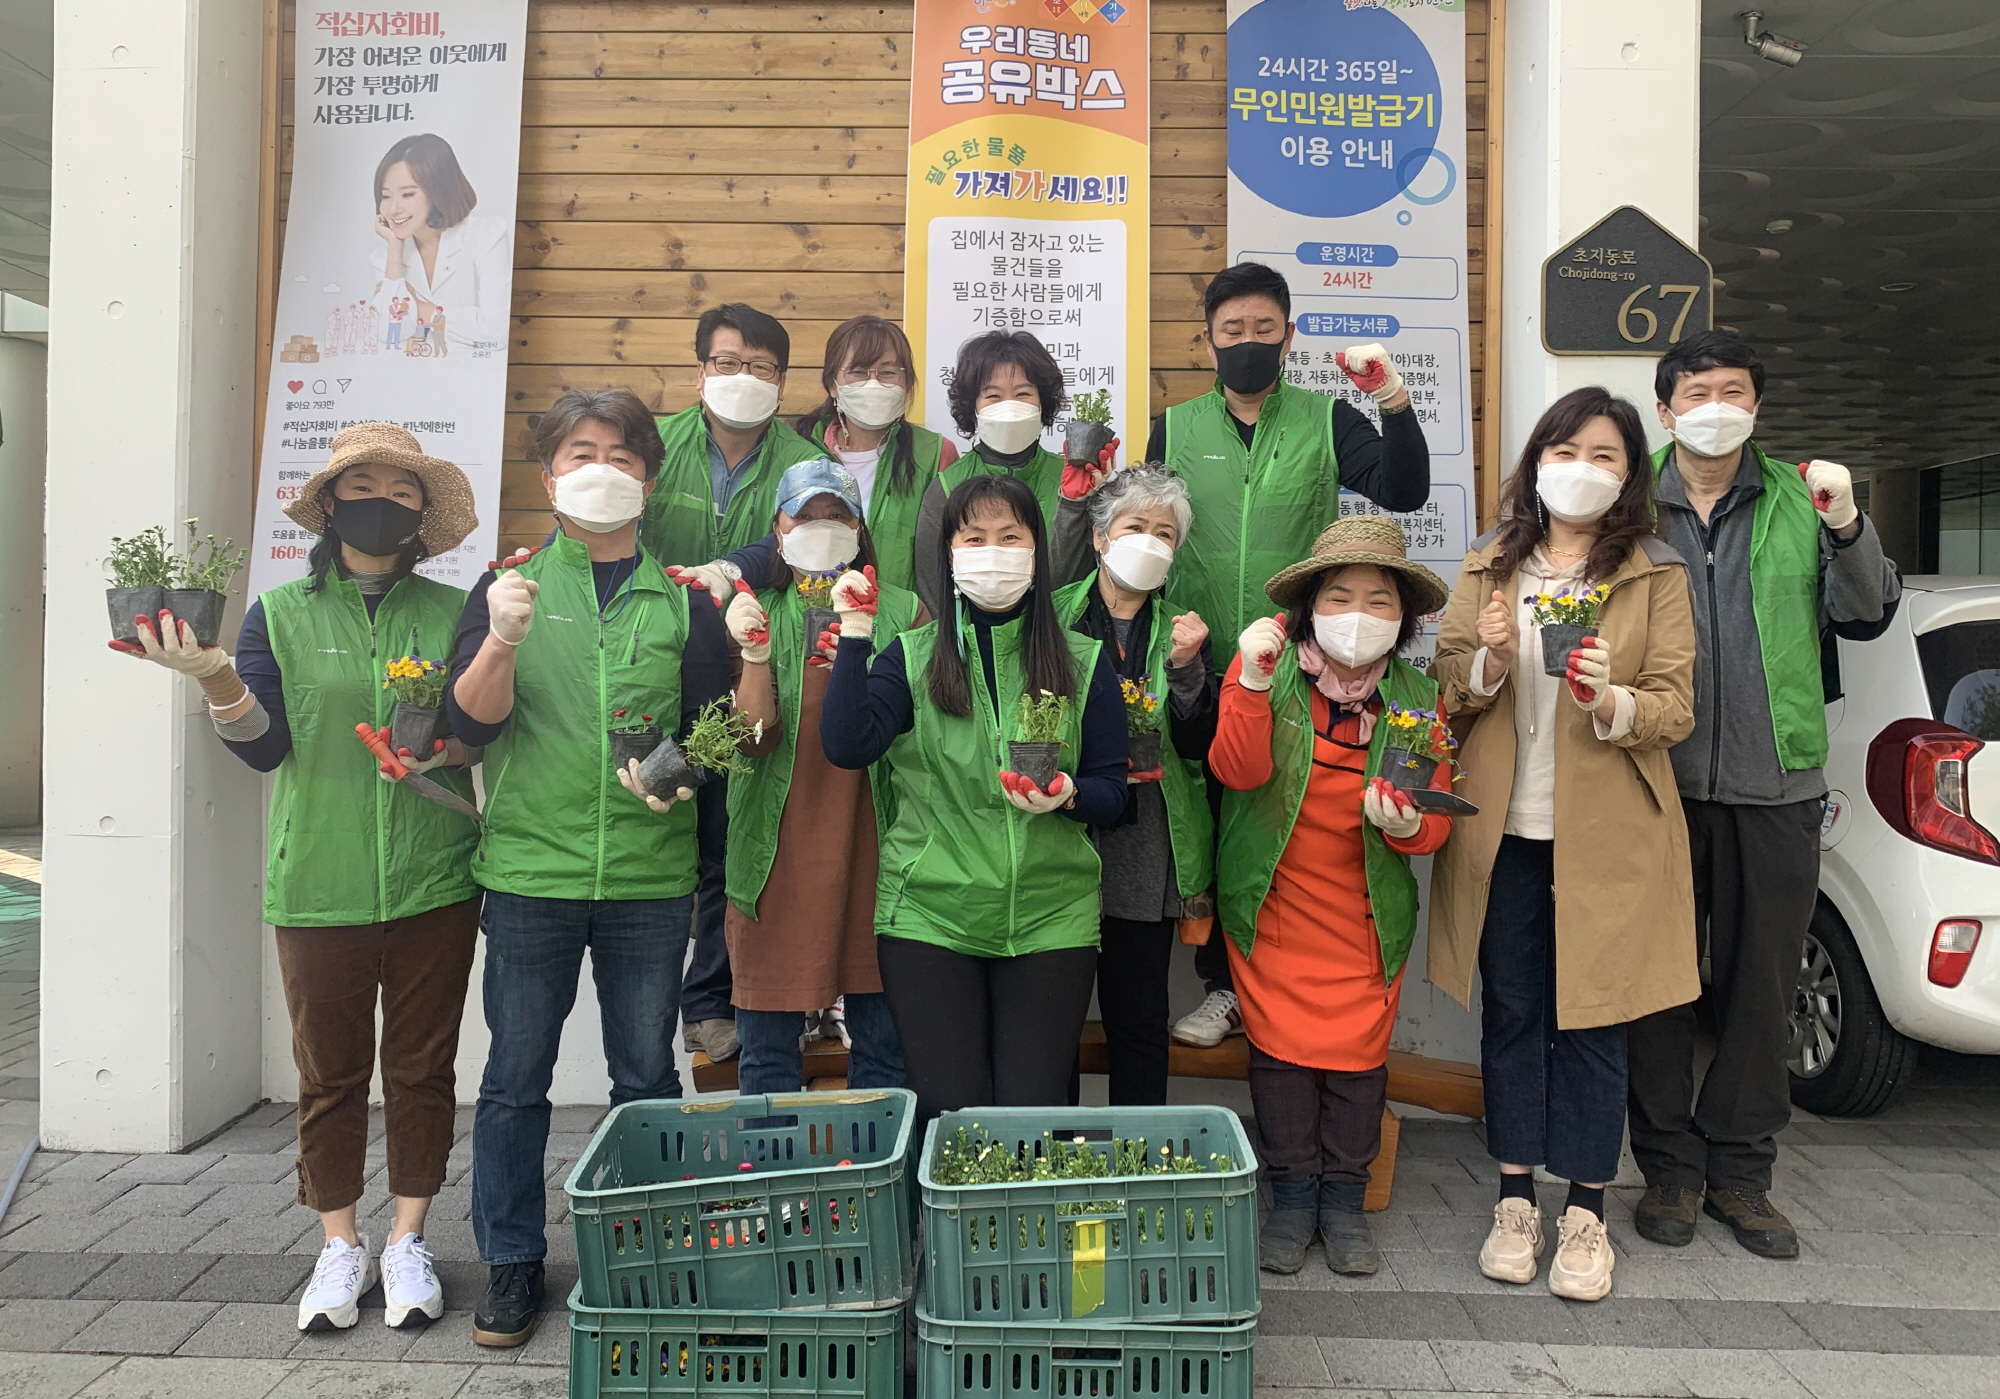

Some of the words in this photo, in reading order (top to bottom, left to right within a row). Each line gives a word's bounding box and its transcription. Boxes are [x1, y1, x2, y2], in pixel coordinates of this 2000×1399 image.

[1108, 2, 1117, 11] 기
[315, 11, 446, 38] 적십자회비,
[960, 25, 1090, 63] 우리동네
[313, 46, 356, 67] 가장
[363, 46, 422, 67] 어려운
[429, 43, 507, 65] 이웃에게
[1258, 56, 1329, 82] 24시간
[1335, 59, 1414, 84] 365일~
[313, 76, 356, 96] 가장
[362, 74, 439, 95] 투명하게
[941, 59, 1127, 110] 공유박스
[313, 103, 414, 125] 사용됩니다.
[1230, 87, 1434, 128] 무인민원발급기
[925, 138, 980, 187] 필요한
[987, 136, 1027, 167] 물품
[1280, 136, 1332, 167] 이용
[1341, 138, 1393, 170] 안내
[954, 168, 1128, 205] 가져가세요!!
[951, 230, 1004, 250] 집에서
[1009, 231, 1063, 253] 잠자고
[1068, 233, 1104, 253] 있는
[1320, 245, 1375, 263] 운영시간
[1572, 247, 1637, 266] 초지동로
[990, 256, 1063, 278] 물건들을
[1559, 266, 1635, 281] Chojidong-ro
[1322, 271, 1373, 289] 24시간
[952, 281, 1007, 302] 필요한
[1011, 281, 1102, 303] 사람들에게
[972, 307, 1081, 328] 기증함으로써
[1307, 315, 1389, 333] 발급가능서류
[1617, 284, 1700, 344] 67
[1322, 351, 1338, 365] 초
[1390, 353, 1439, 368] 야)대장,
[1062, 366, 1114, 386] 들에게
[285, 401, 310, 411] 좋아요
[312, 400, 335, 410] 793만
[1407, 390, 1440, 405] 원부,
[1413, 409, 1440, 423] 명서,
[283, 420, 338, 432] #적십자회비
[402, 421, 456, 433] #1년에한번
[278, 470, 310, 480] 함께하는
[1339, 501, 1444, 516] 동행정터,
[271, 529, 296, 540] 도움을
[270, 545, 307, 559] 160만
